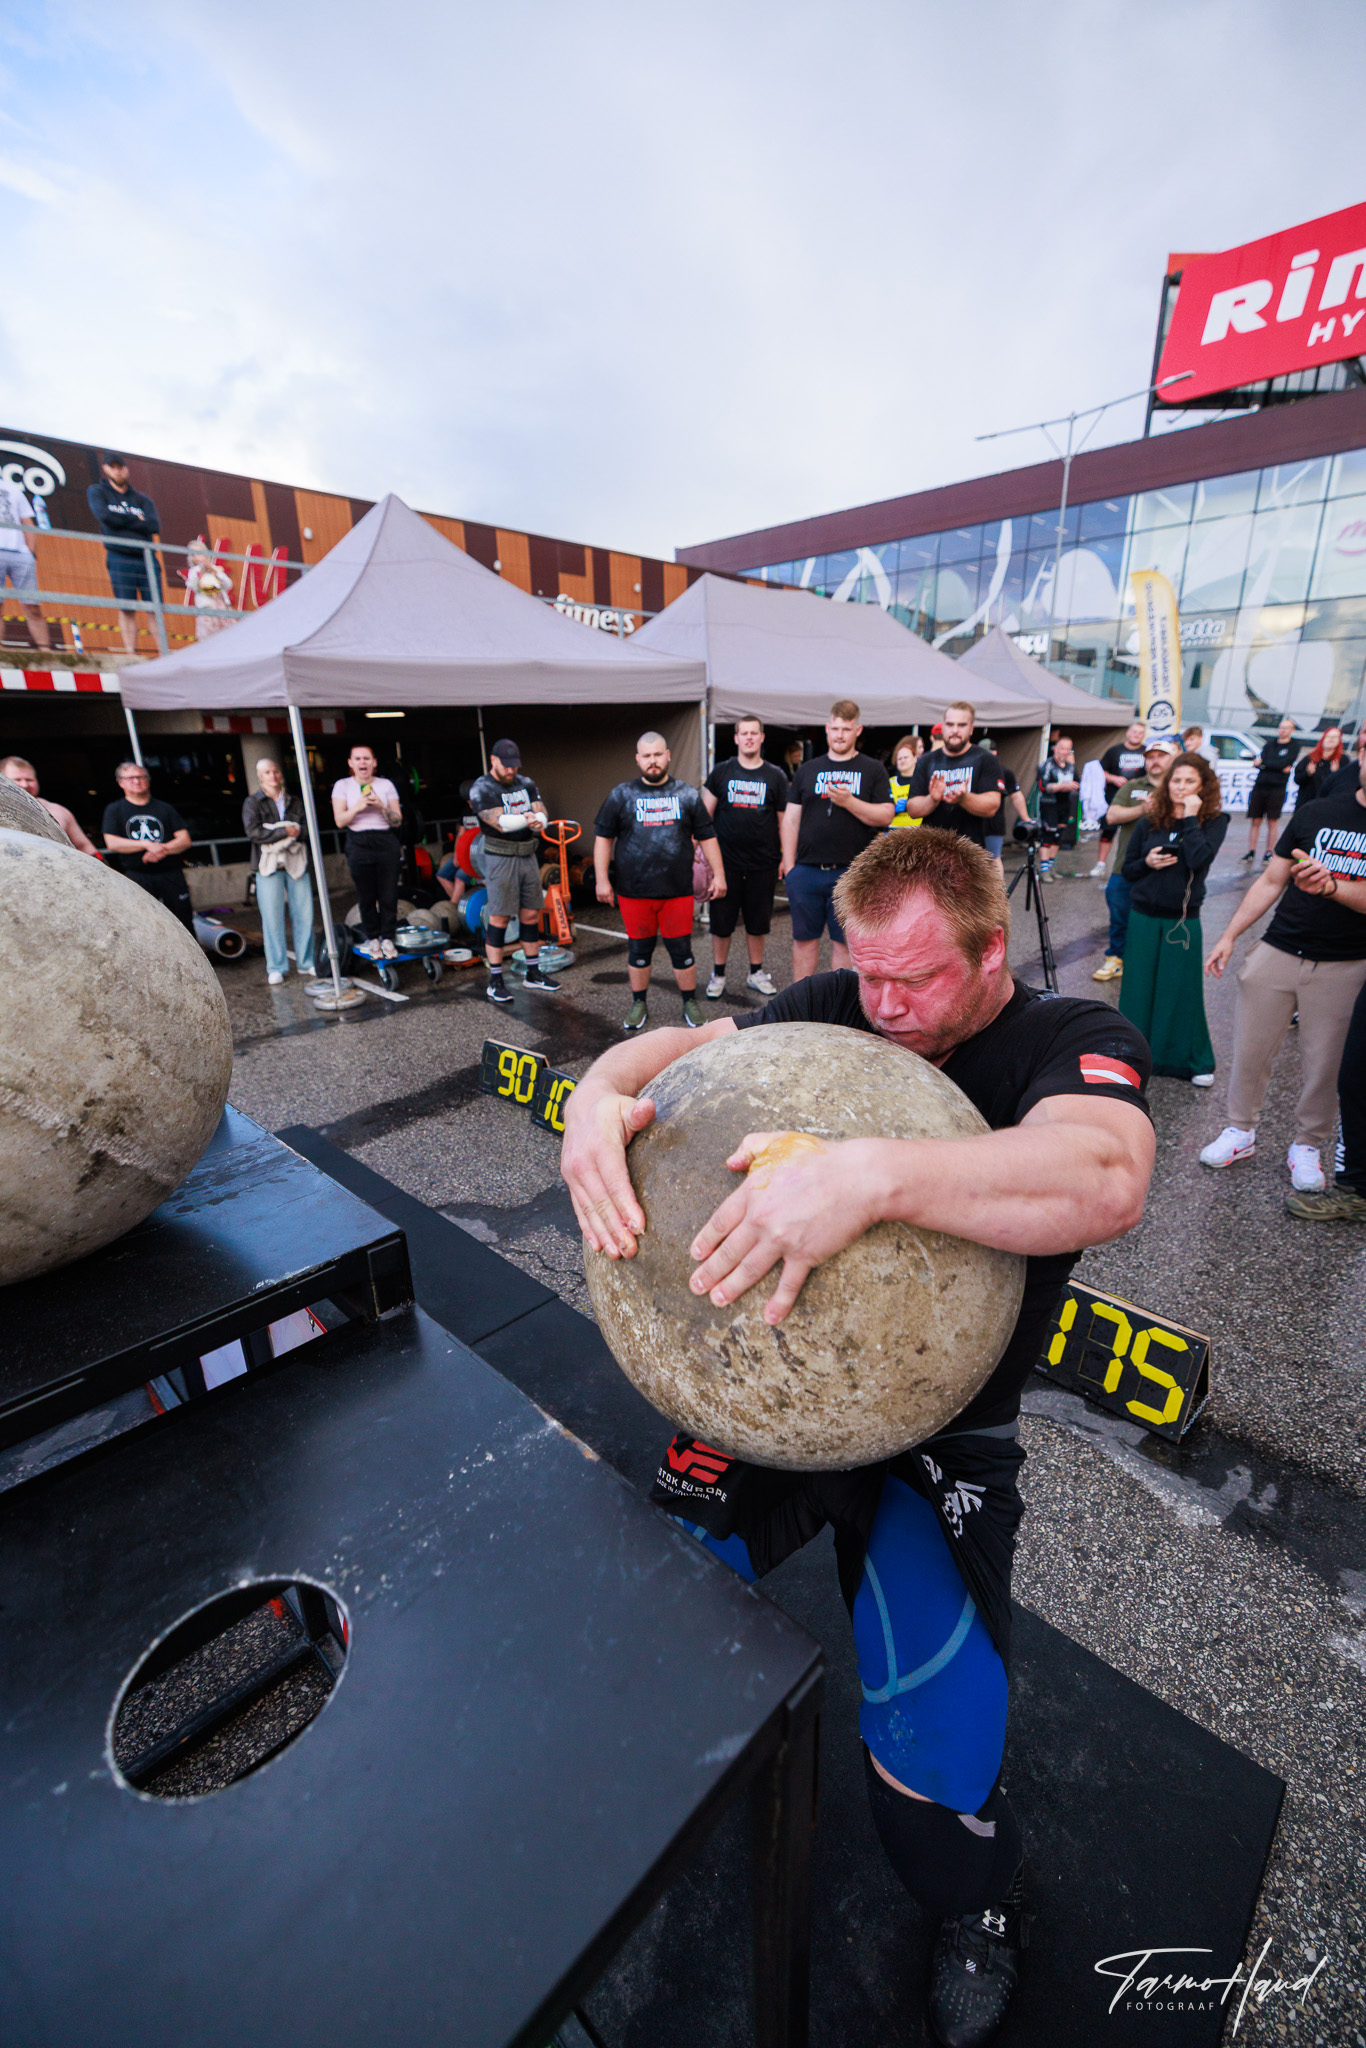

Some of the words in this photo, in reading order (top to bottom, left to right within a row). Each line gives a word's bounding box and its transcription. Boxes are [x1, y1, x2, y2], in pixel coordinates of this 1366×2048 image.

[498, 1049, 537, 1104] 90
[1048, 1298, 1185, 1426] 175
[681, 1480, 728, 1503] EUROPE
